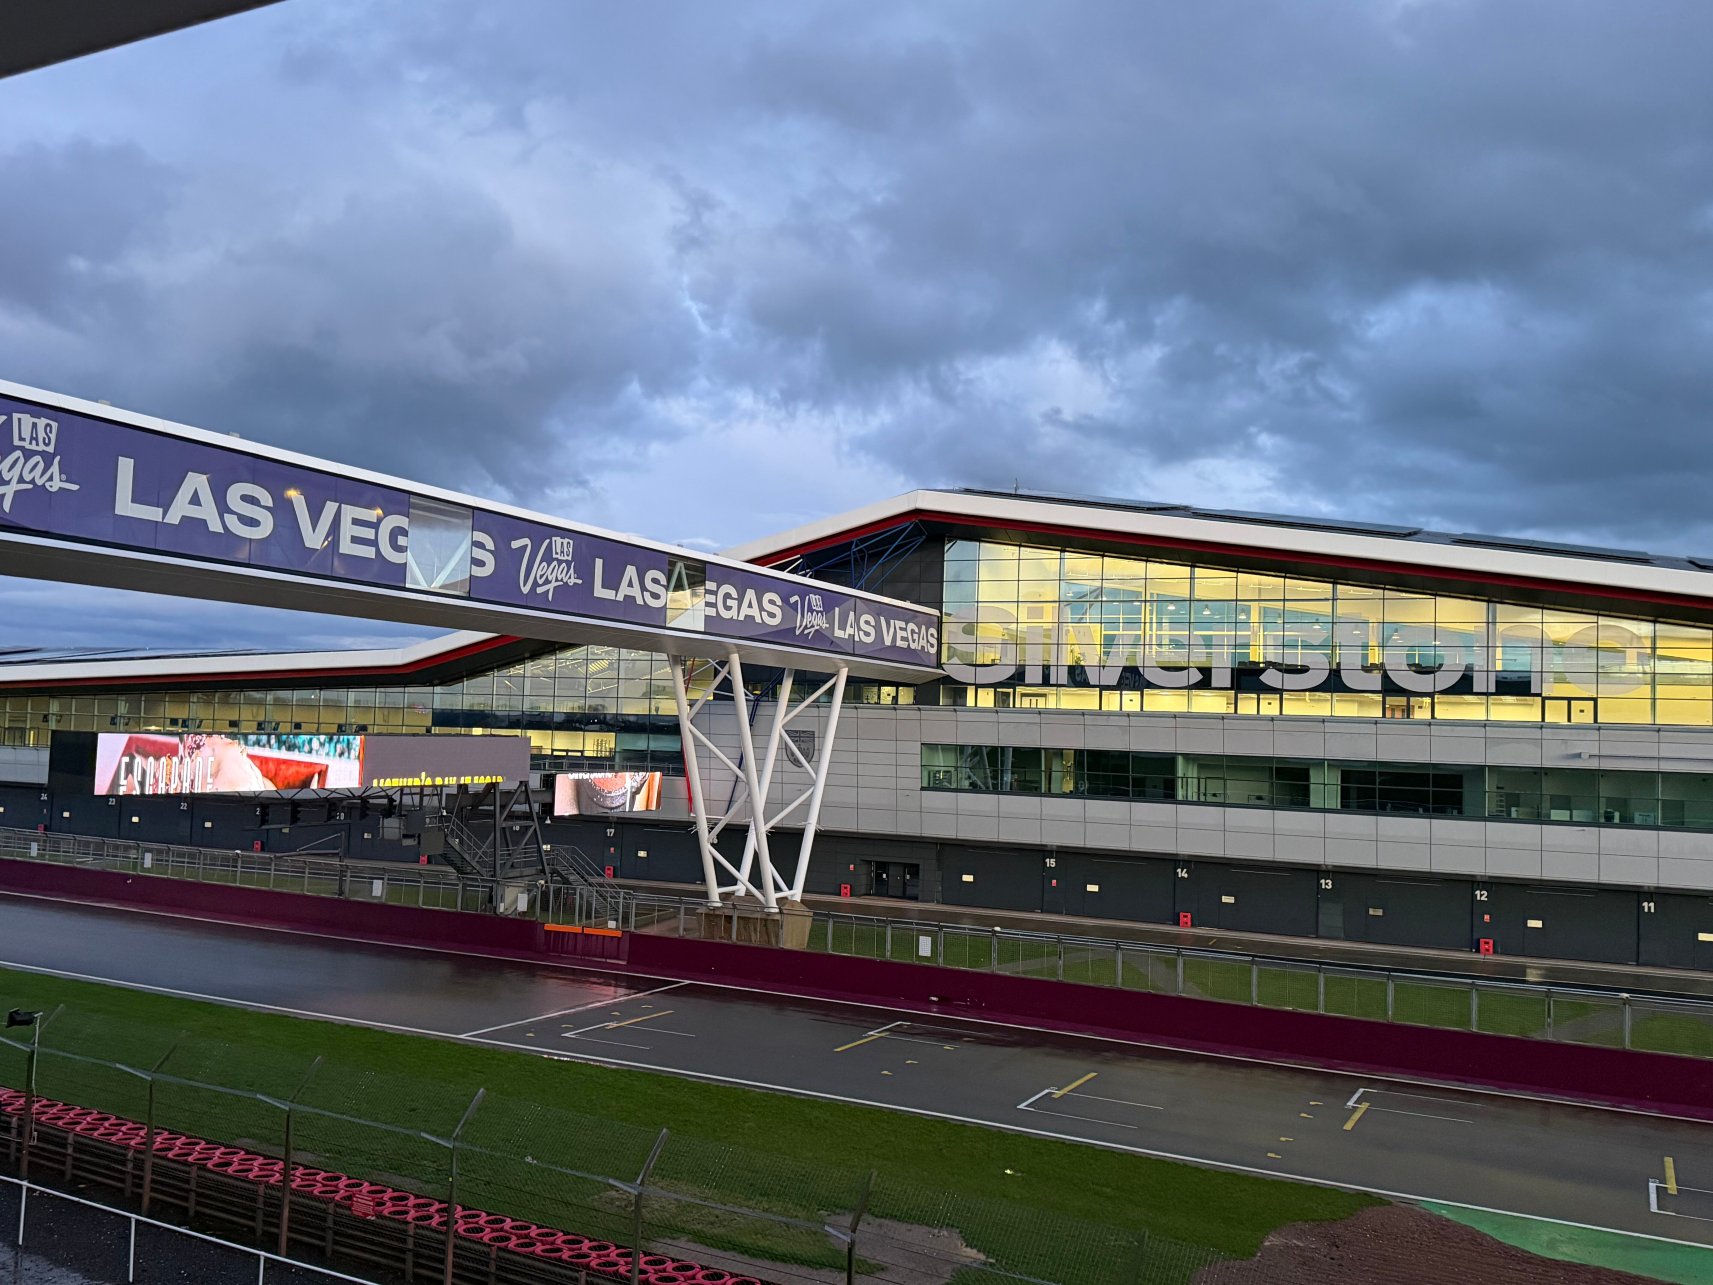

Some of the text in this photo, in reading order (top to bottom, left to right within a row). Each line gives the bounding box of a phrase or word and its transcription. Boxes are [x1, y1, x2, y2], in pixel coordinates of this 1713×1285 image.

[17, 417, 53, 447] LAS
[0, 415, 80, 513] gas
[115, 456, 495, 577] LAS VEGS
[554, 539, 571, 556] LAS
[511, 538, 582, 601] Vegas
[594, 557, 782, 626] LAS EGAS
[789, 595, 829, 639] Vegas
[834, 607, 938, 654] LAS VEGAS
[941, 604, 1651, 696] Silverstone
[606, 828, 615, 837] 17
[1045, 858, 1056, 868] 15
[1176, 868, 1189, 879] 14
[1320, 879, 1333, 889] 13
[1475, 890, 1488, 901] 12
[1642, 901, 1655, 913] 11
